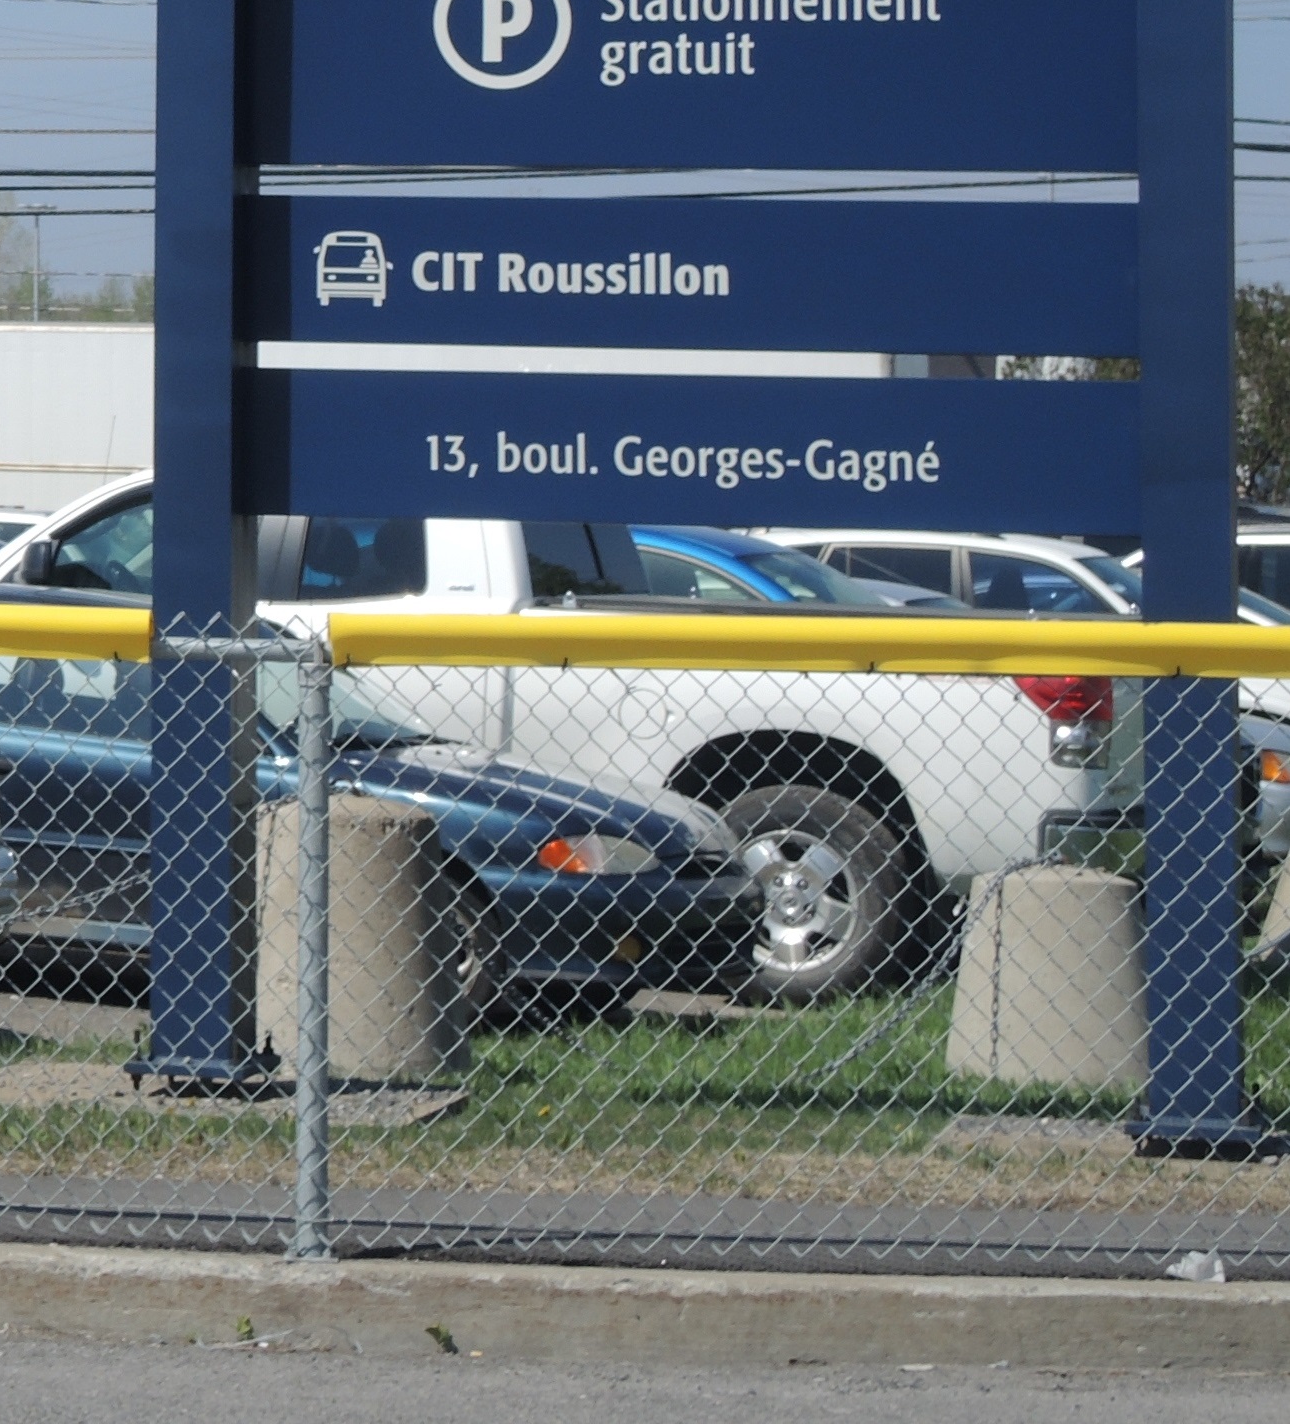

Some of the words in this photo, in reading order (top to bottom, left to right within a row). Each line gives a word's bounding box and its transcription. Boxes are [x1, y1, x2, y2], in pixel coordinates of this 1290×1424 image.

[599, 31, 756, 88] gratuit
[411, 250, 484, 292] CIT
[497, 251, 731, 297] Roussillon
[425, 433, 480, 479] 13,
[496, 430, 600, 476] boul.
[612, 434, 941, 493] Georges-Gagné
